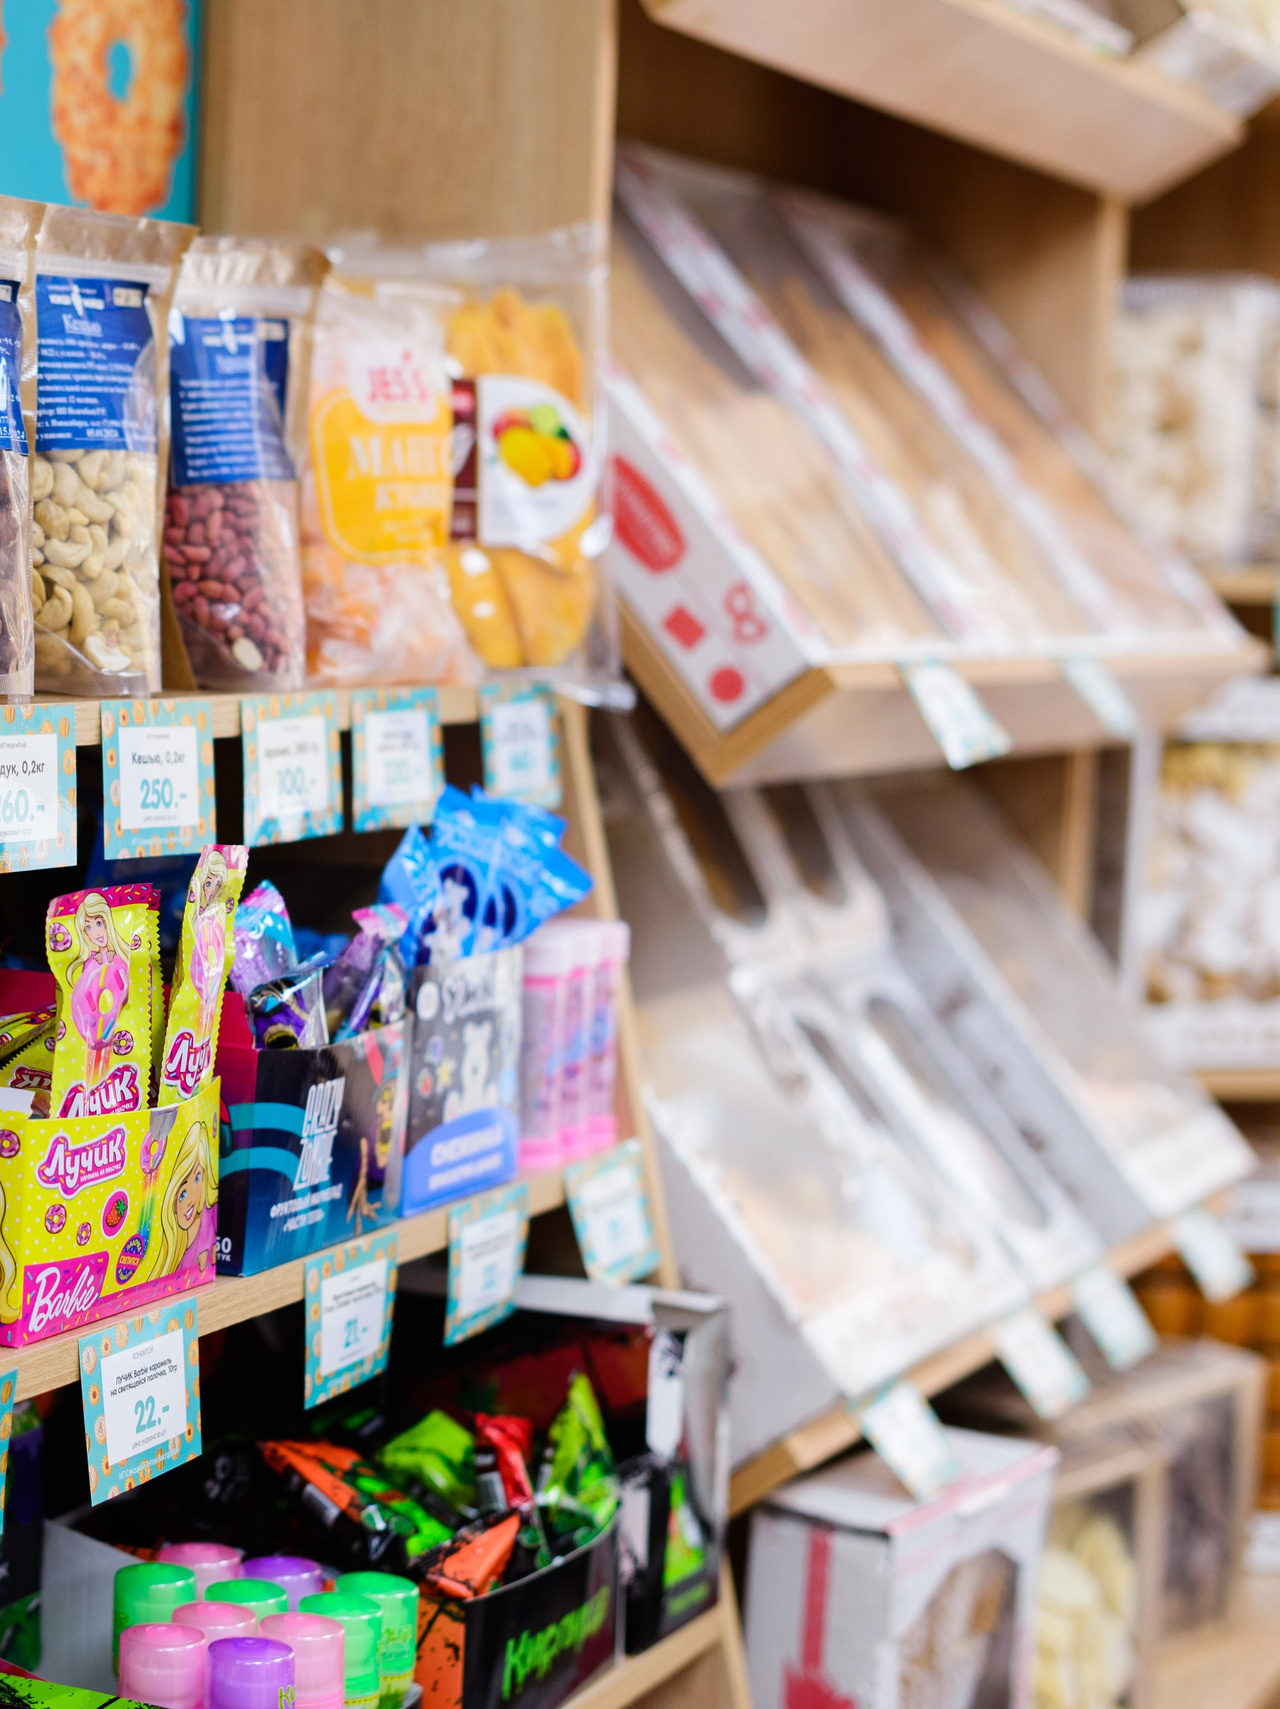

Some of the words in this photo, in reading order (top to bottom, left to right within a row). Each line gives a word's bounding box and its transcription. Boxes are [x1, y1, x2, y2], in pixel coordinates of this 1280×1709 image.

[22, 760, 45, 776] 0,2кг
[131, 752, 163, 766] Кешью,
[165, 751, 185, 766] 0,2кг
[140, 778, 187, 809] 250.-
[302, 1076, 345, 1138] CRAZY
[44, 1133, 122, 1187] Лучик
[29, 1265, 98, 1332] Barbie
[111, 1388, 118, 1396] на
[118, 1377, 146, 1394] светящейся
[147, 1368, 167, 1382] палочке,
[168, 1364, 178, 1374] 10гр
[115, 1371, 133, 1385] ЛУЧИК
[134, 1366, 148, 1378] Barbie
[149, 1358, 172, 1372] карамель
[134, 1395, 170, 1434] 22.-
